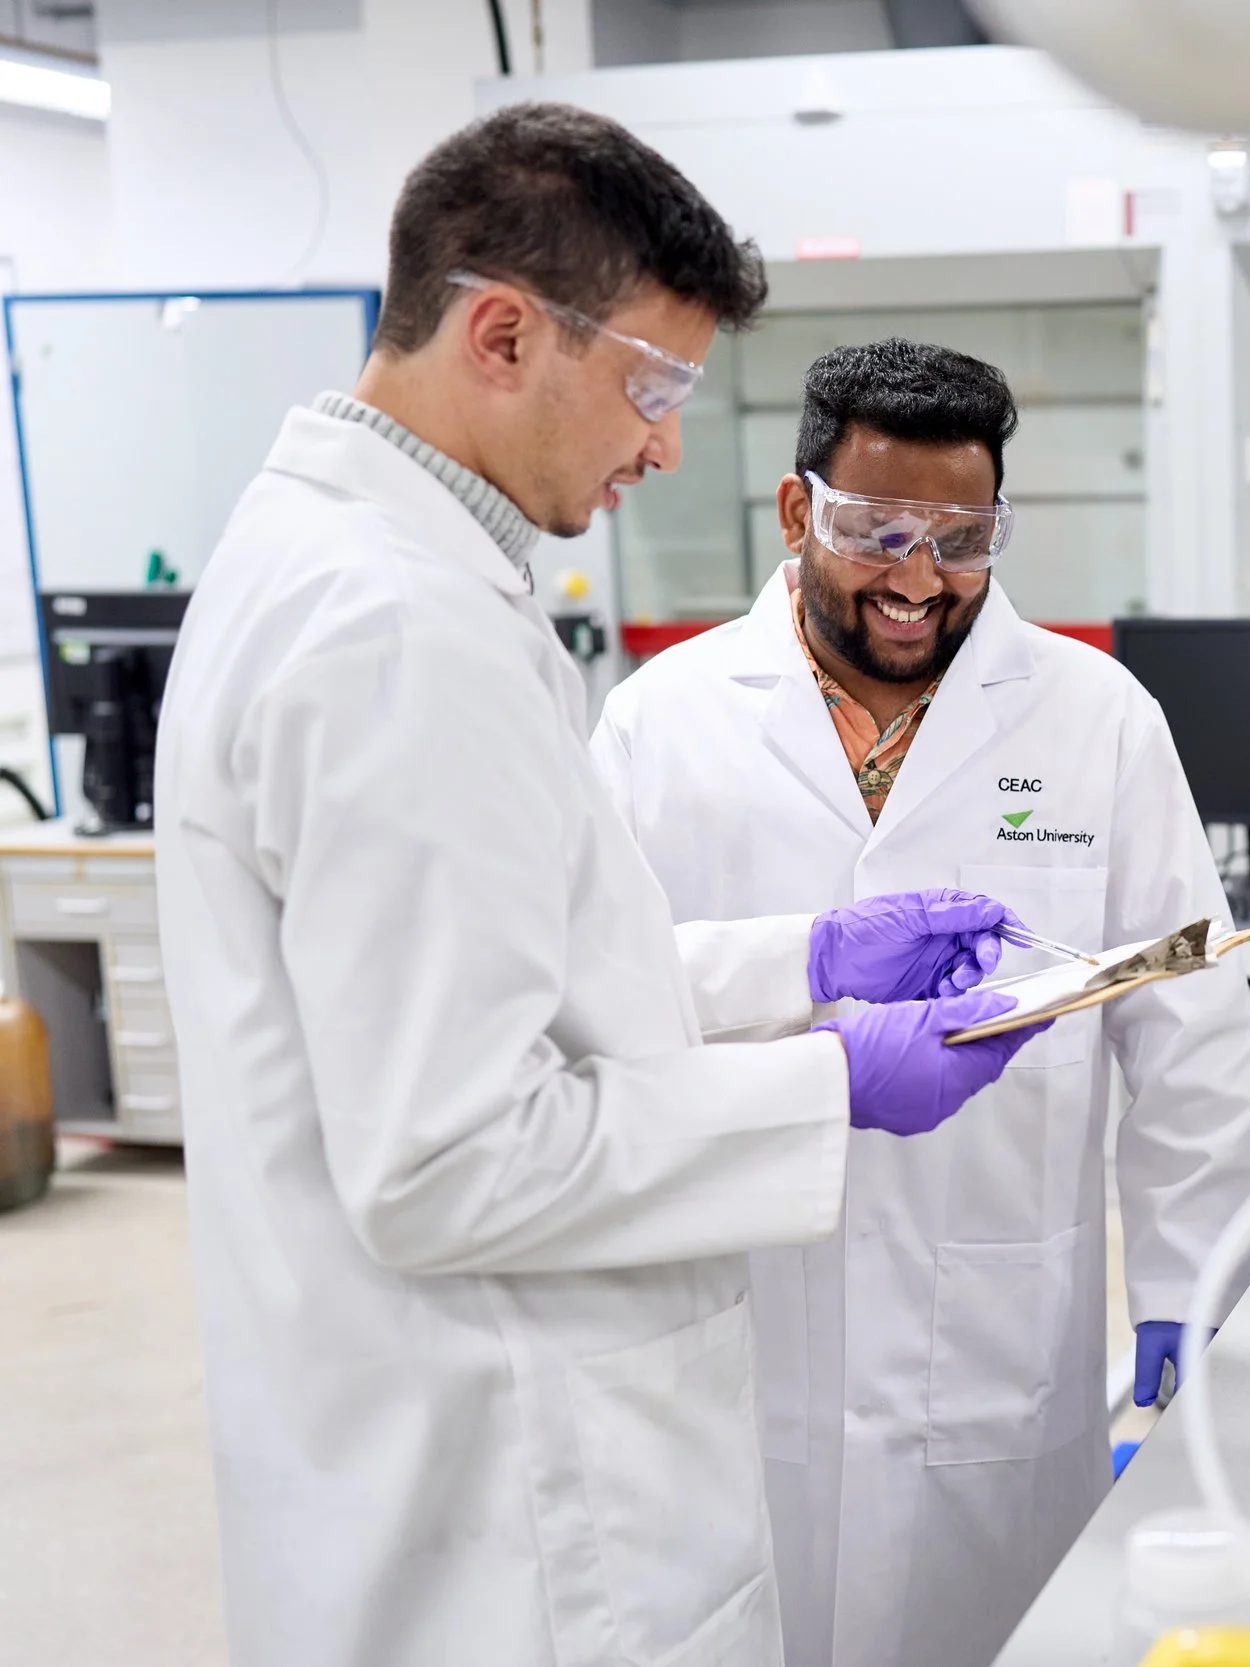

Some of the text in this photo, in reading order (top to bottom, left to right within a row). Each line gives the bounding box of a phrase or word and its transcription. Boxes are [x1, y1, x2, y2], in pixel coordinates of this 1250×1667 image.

[998, 777, 1042, 792] CEAC
[996, 827, 1095, 847] Aston University
